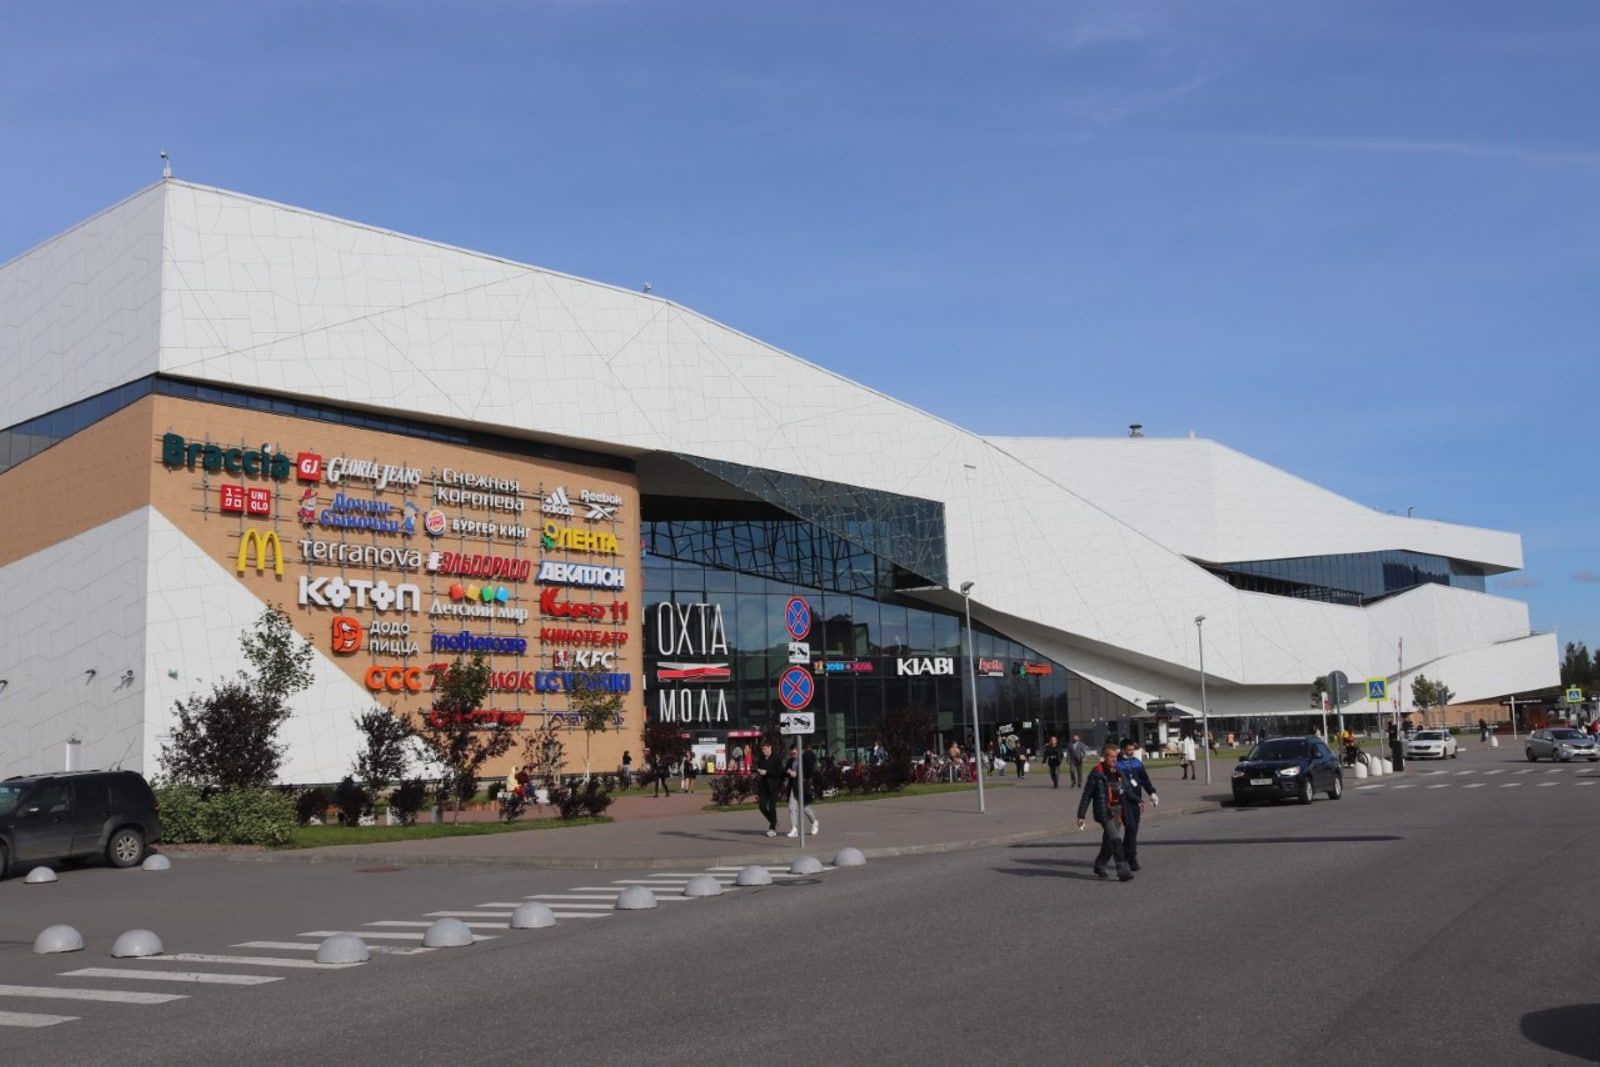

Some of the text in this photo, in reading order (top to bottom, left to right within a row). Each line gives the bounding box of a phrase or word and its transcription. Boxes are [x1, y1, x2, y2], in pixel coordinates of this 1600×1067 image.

[162, 432, 290, 480] Braccia
[377, 464, 422, 490] JEANS
[442, 467, 520, 492] Снежная
[250, 490, 268, 501] UNI
[250, 501, 269, 512] QLO
[437, 486, 525, 511] Королева
[580, 489, 623, 504] Reebok
[541, 504, 575, 516] adidas
[452, 519, 530, 538] БУРГЕР КИНГ
[557, 526, 620, 552] ЛЕНТА
[299, 539, 422, 567] terranova
[441, 551, 531, 581] ЭЛЬДОРАДО
[538, 561, 625, 587] ДЕКАТЛОН
[430, 599, 529, 624] Детский мир
[369, 620, 410, 636] ДОДО
[540, 627, 628, 646] КИНОТЕАТР
[657, 601, 729, 656] ОХТА
[369, 639, 419, 656] ПИЦЦА
[431, 630, 528, 654] mothercare
[575, 649, 615, 669] KFC
[896, 657, 954, 676] KIABI
[535, 671, 562, 692] LC
[659, 687, 730, 723] МОЛЛ
